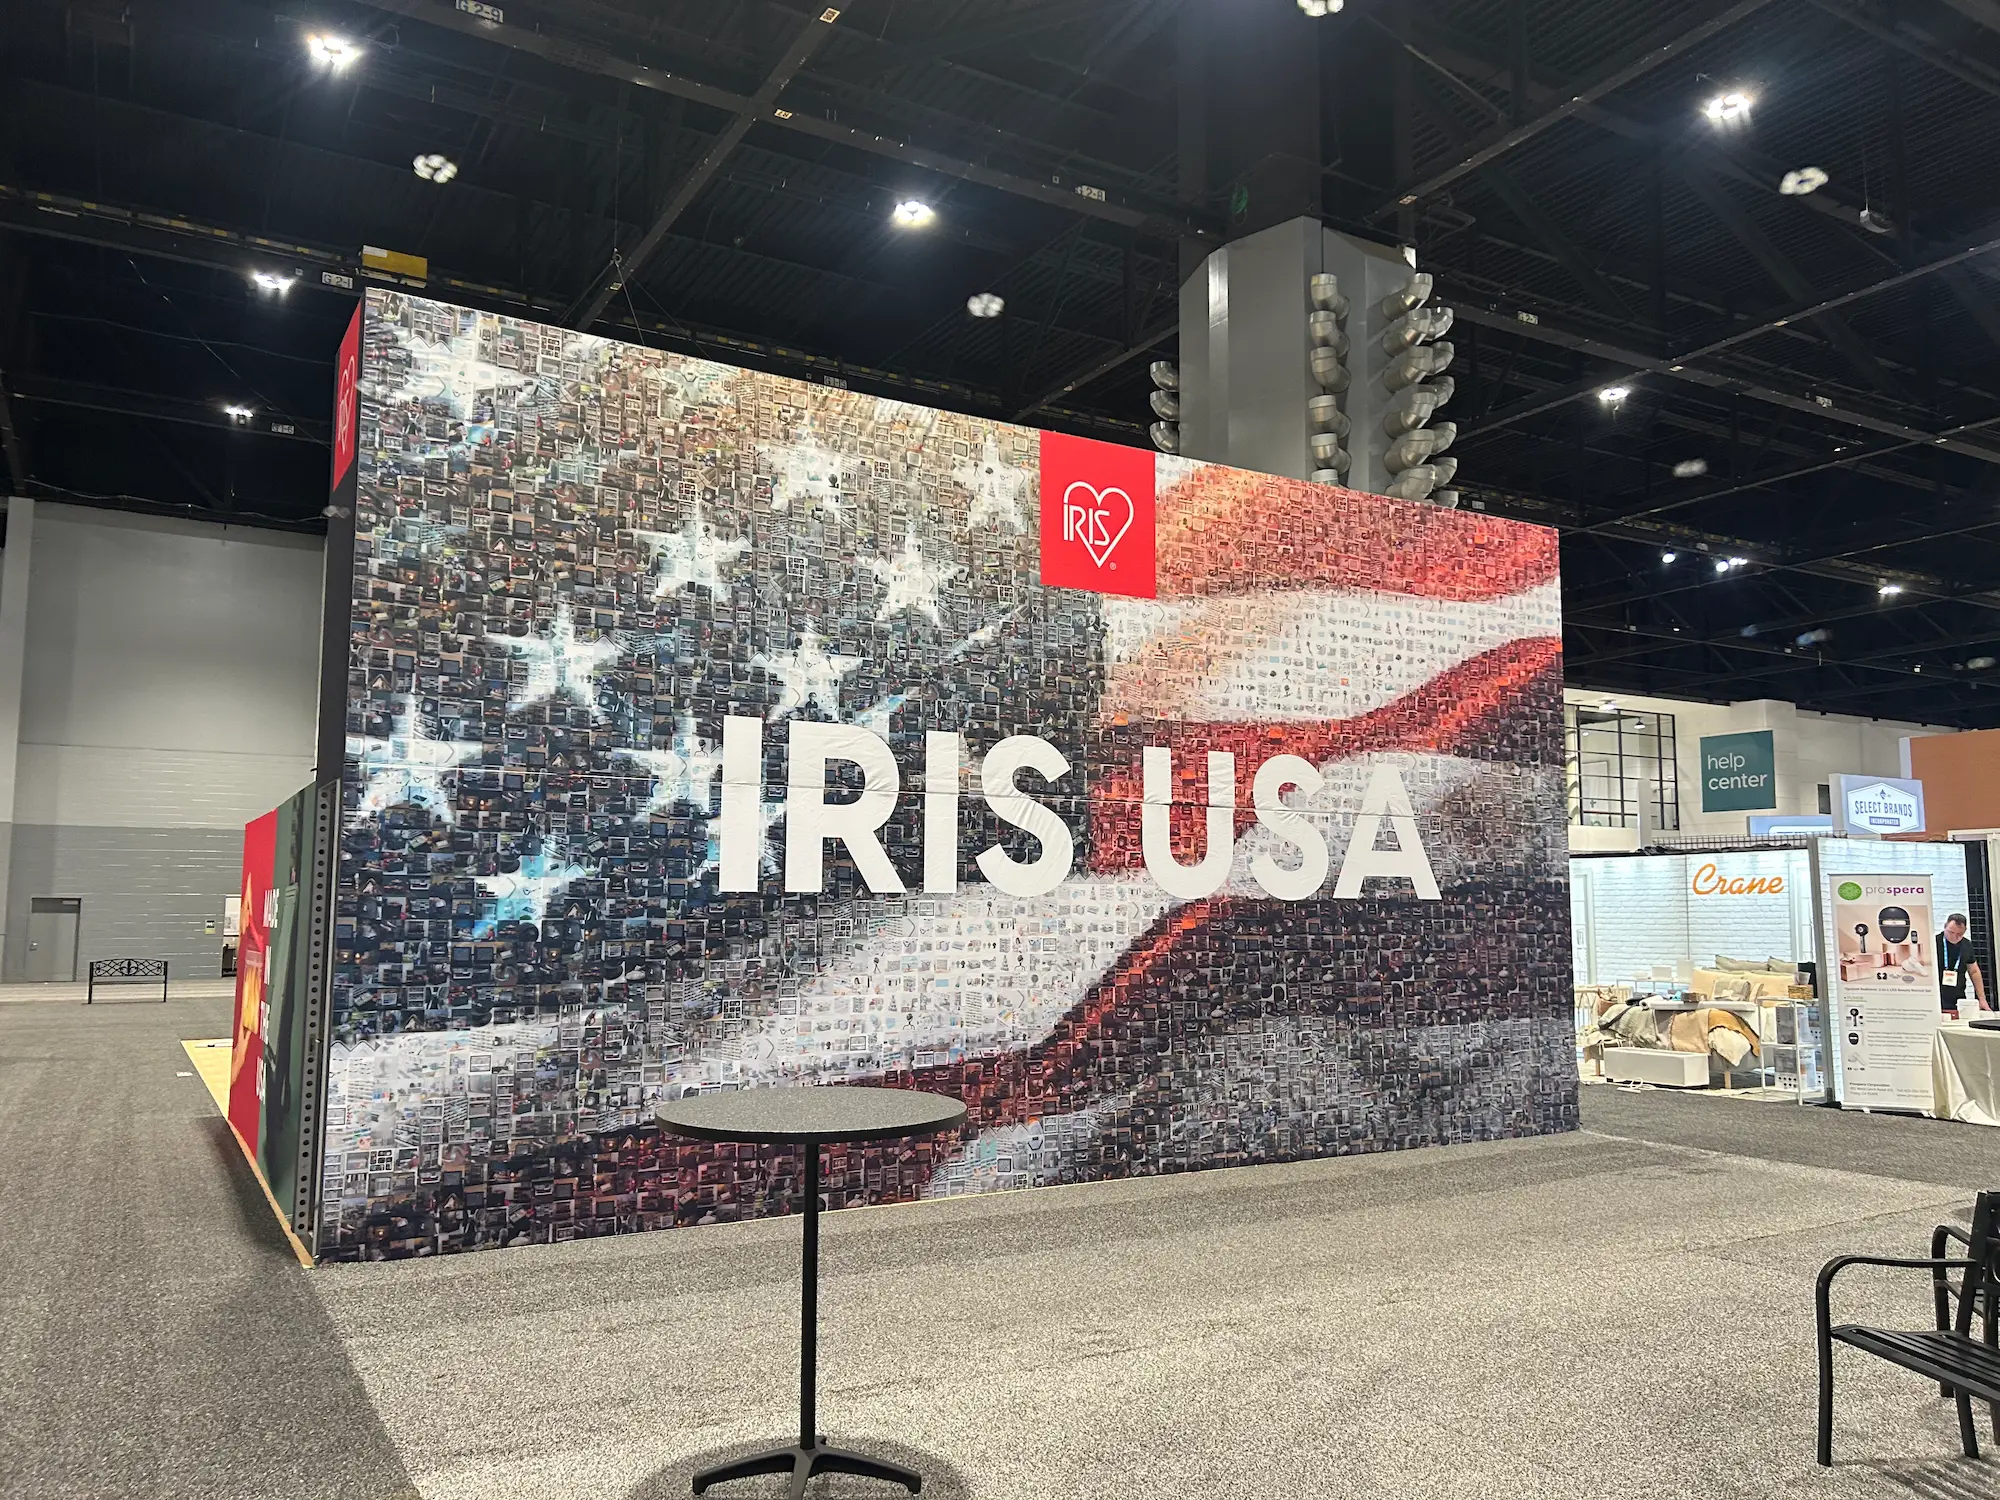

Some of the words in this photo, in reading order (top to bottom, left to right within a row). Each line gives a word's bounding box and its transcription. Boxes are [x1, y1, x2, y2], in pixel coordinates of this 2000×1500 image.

[1063, 503, 1111, 547] IRIS
[1707, 752, 1745, 772] help
[1708, 773, 1768, 790] center
[718, 714, 1075, 899] IRIS
[1141, 746, 1442, 901] USA
[1854, 800, 1881, 815] SELECT
[1884, 803, 1913, 817] BRANDS
[1692, 863, 1784, 895] Crane
[1865, 886, 1925, 897] prospera
[263, 888, 279, 928] MADE
